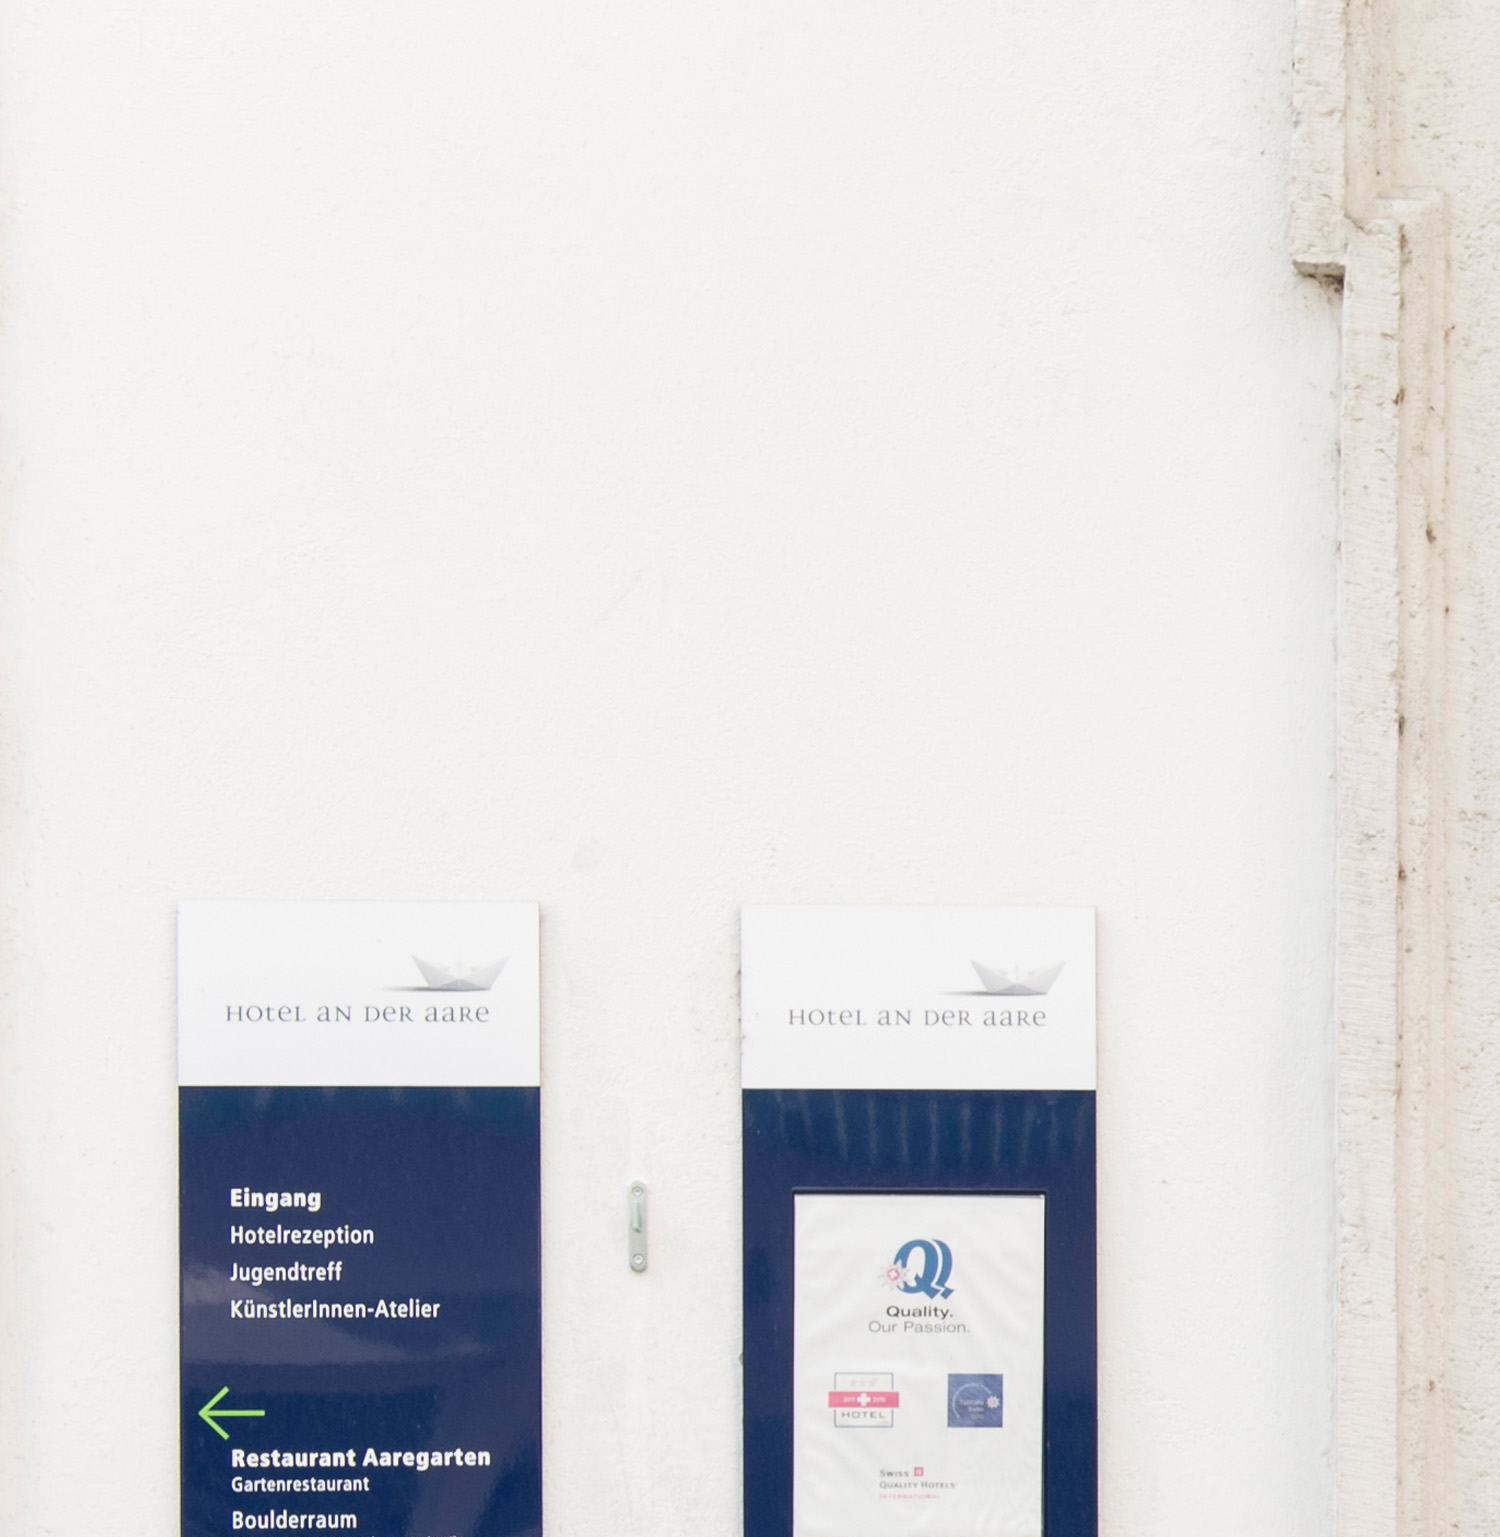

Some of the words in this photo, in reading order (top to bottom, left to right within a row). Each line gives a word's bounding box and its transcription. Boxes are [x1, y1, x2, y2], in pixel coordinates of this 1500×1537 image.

[230, 1187, 322, 1212] Eingang
[230, 1224, 374, 1248] Hotelrezeption
[229, 1261, 343, 1286] Jugendtreff
[230, 1298, 441, 1319] KünstlerInnen-Atelier
[885, 1305, 954, 1320] Quality.
[868, 1320, 898, 1333] Our
[903, 1320, 971, 1334] Passion.
[841, 1411, 886, 1420] HOTEL
[231, 1448, 357, 1468] Restaurant
[362, 1448, 491, 1471] Aaregarten
[231, 1477, 370, 1493] Gartenrestaurant
[879, 1480, 918, 1491] QUALITY
[232, 1509, 358, 1530] Boulderraum
